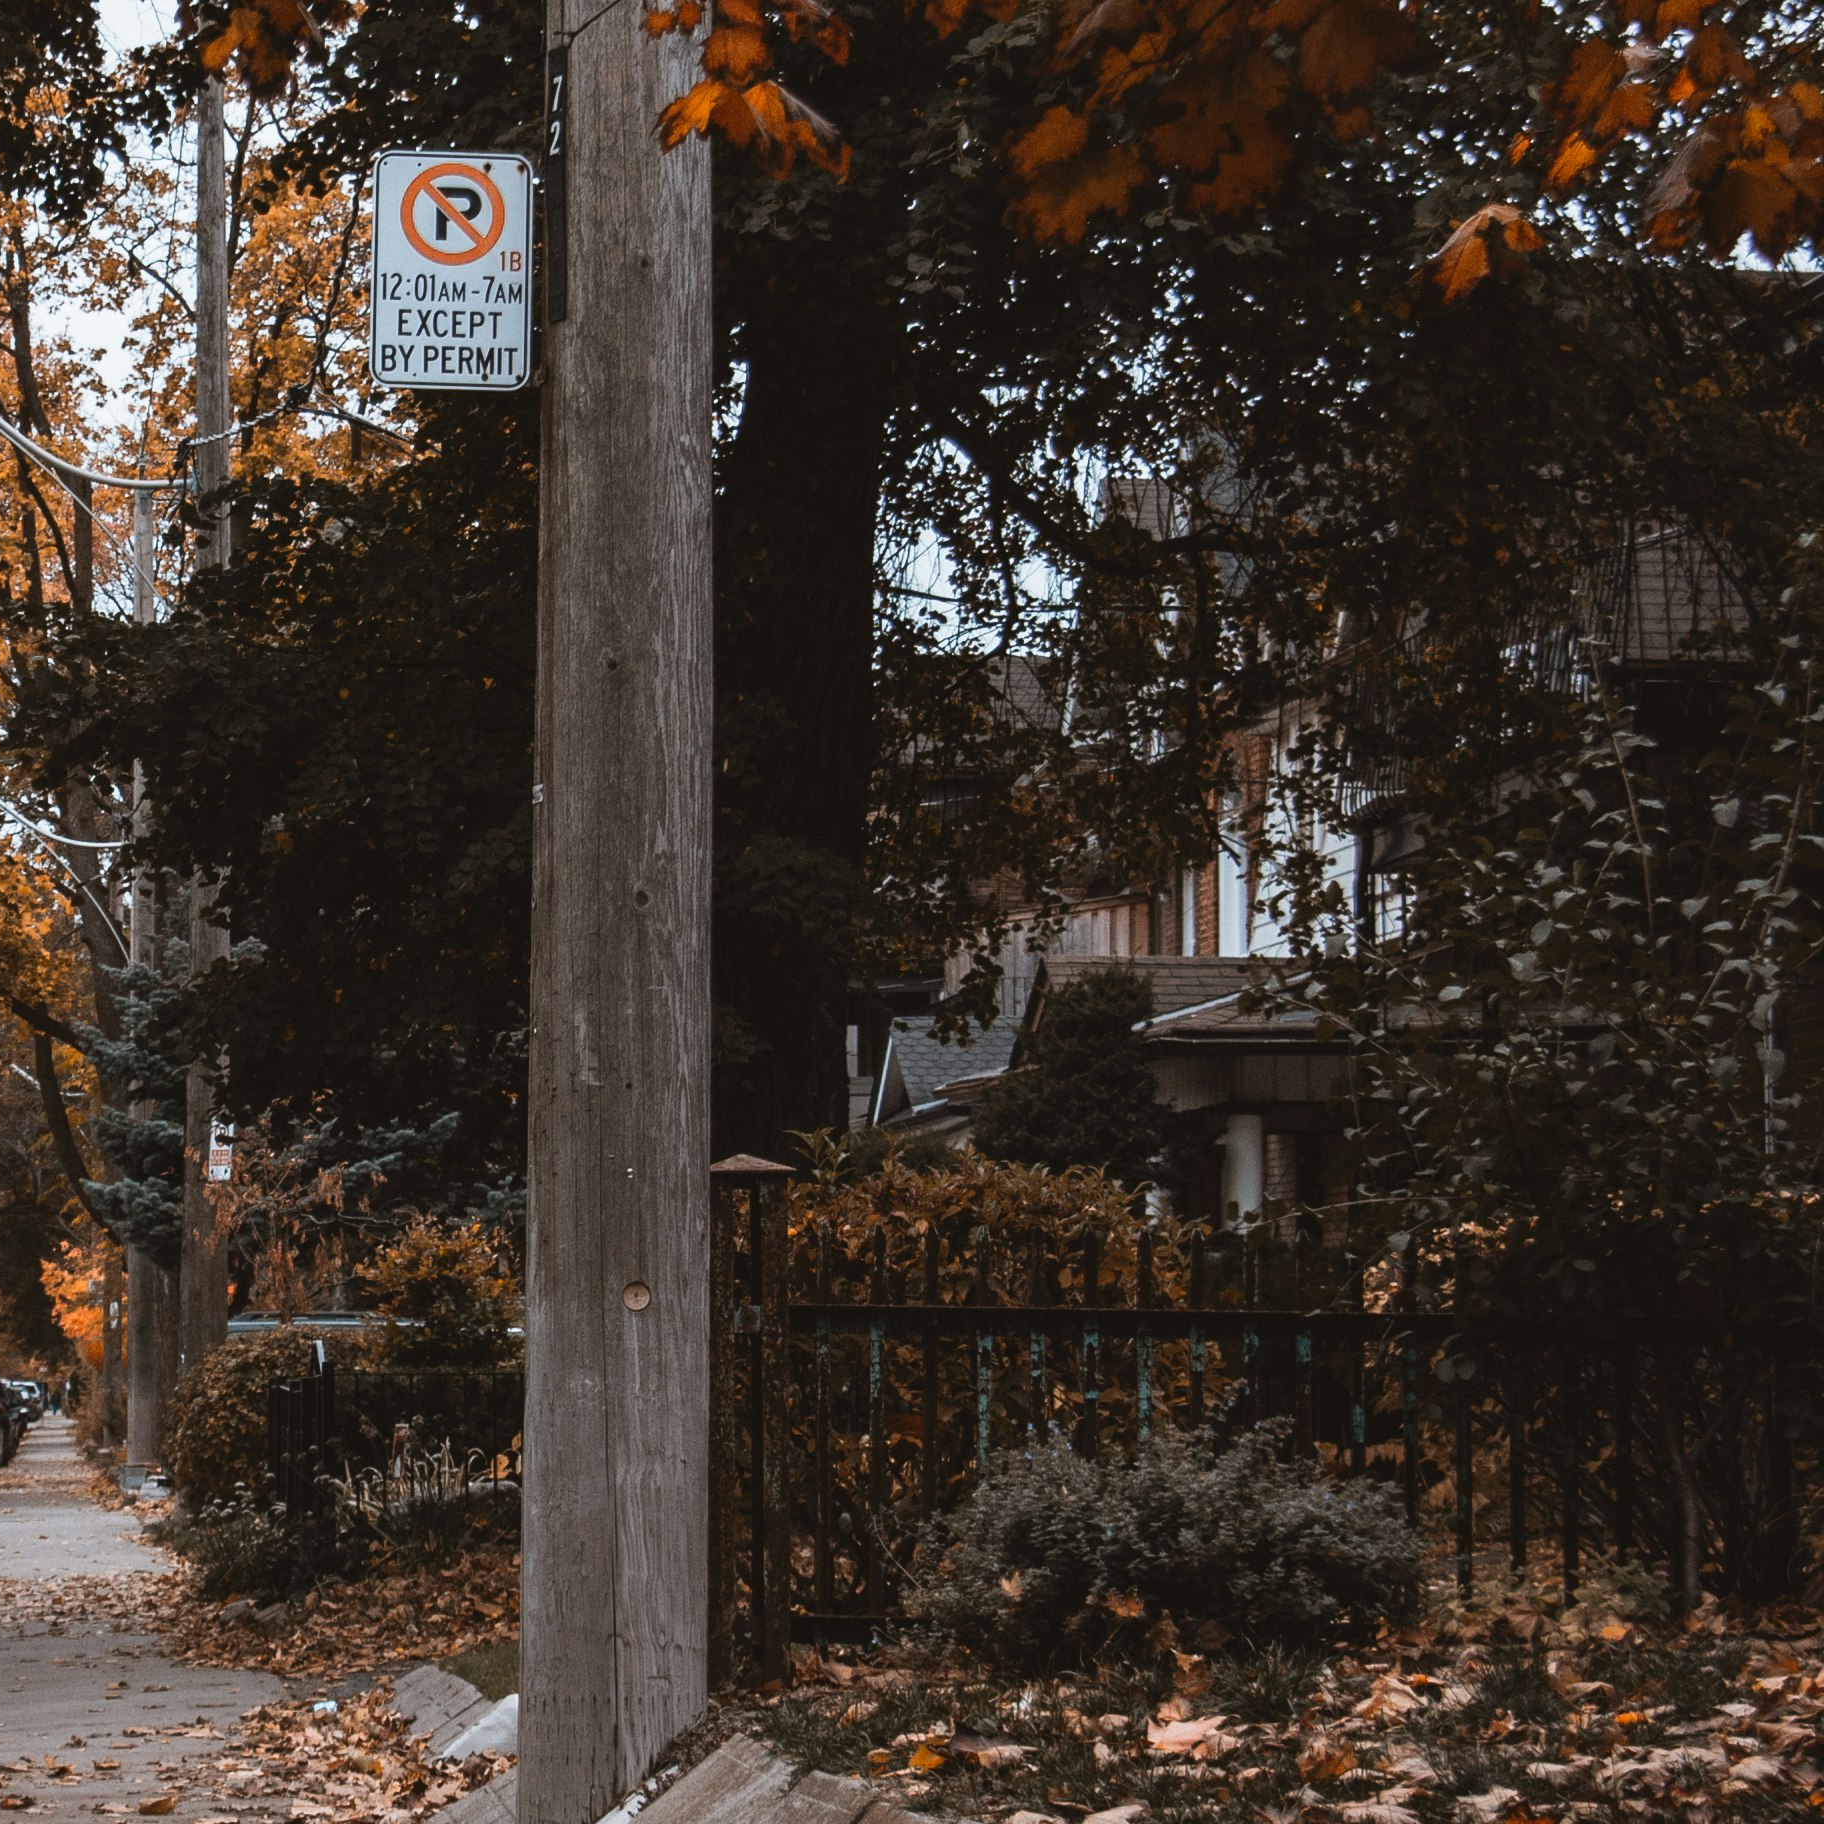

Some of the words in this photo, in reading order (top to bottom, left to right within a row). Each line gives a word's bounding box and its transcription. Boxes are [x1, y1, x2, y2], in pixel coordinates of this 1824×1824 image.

[499, 250, 522, 273] 1B
[397, 308, 503, 340] EXCEPT
[381, 344, 415, 373] BY
[423, 345, 518, 376] PERMIT
